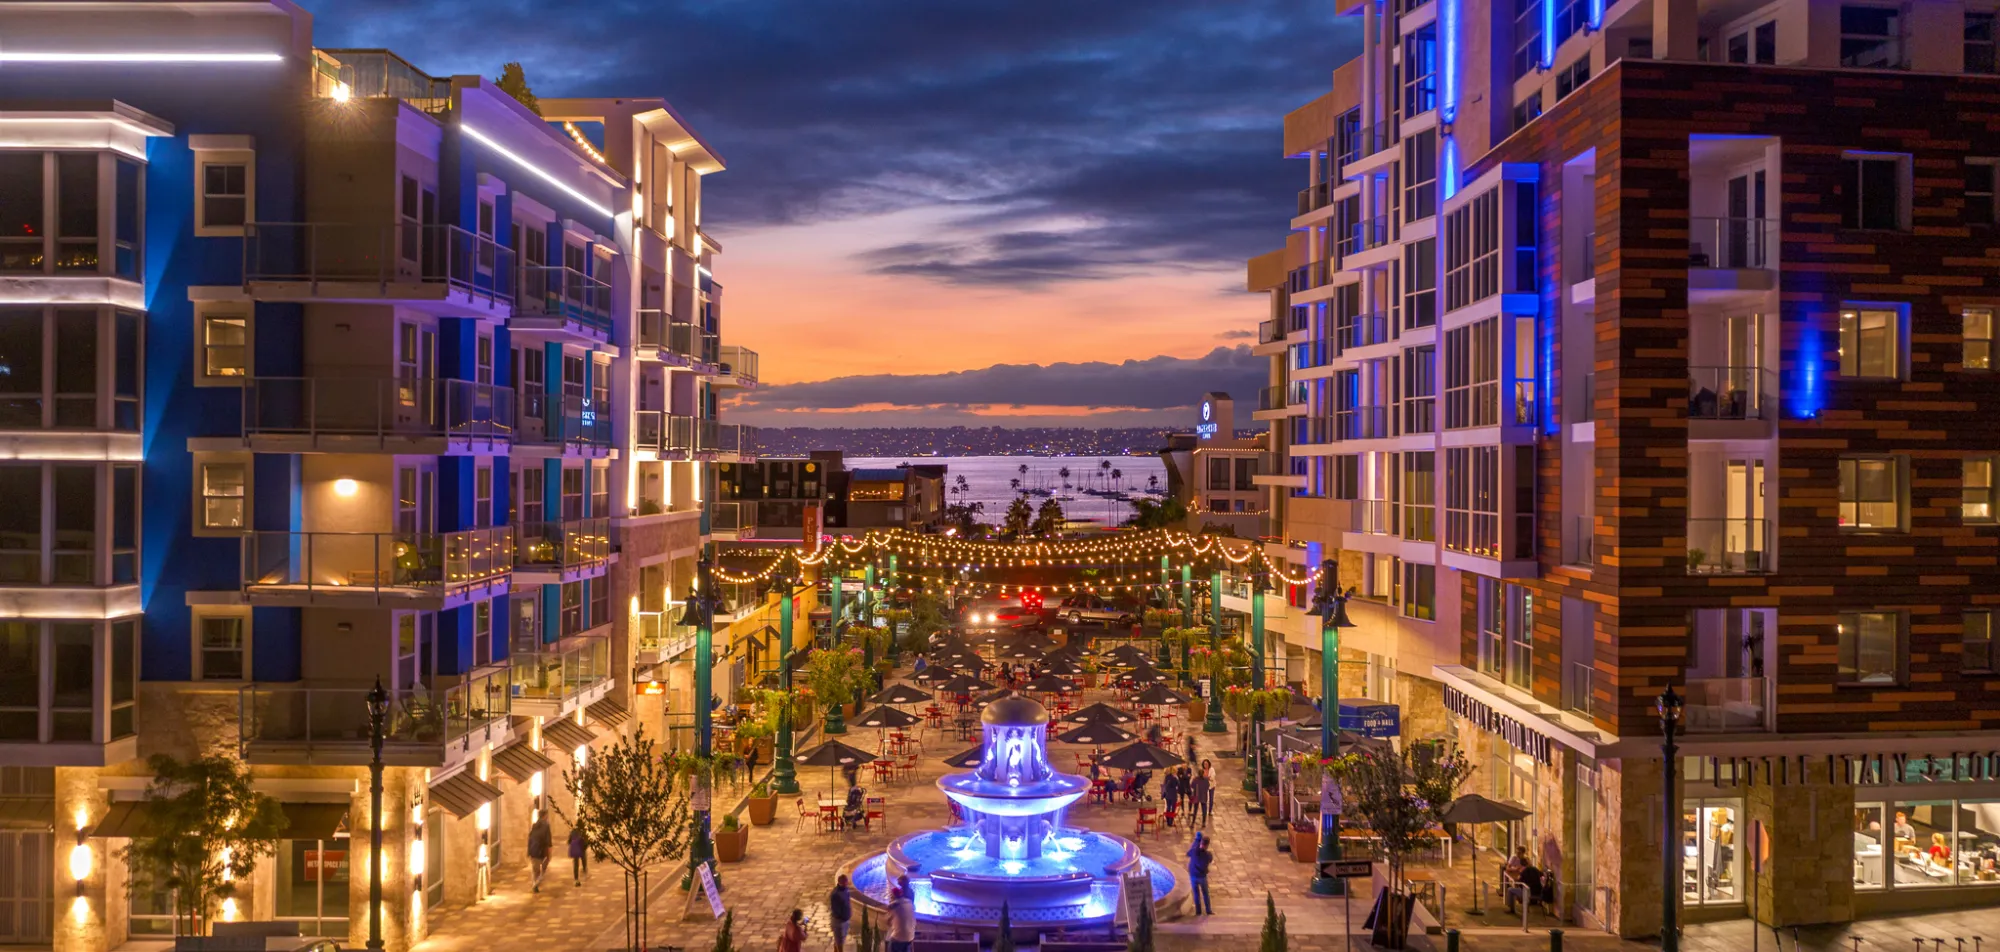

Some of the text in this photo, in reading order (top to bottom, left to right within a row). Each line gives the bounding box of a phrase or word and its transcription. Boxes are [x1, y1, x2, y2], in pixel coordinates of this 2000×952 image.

[1442, 682, 1552, 767] LITTLE ITALY FOOD HALL
[1713, 754, 1812, 788] LITTLE
[1827, 753, 1908, 785] ITALY
[1336, 864, 1367, 874] ONE WAY
